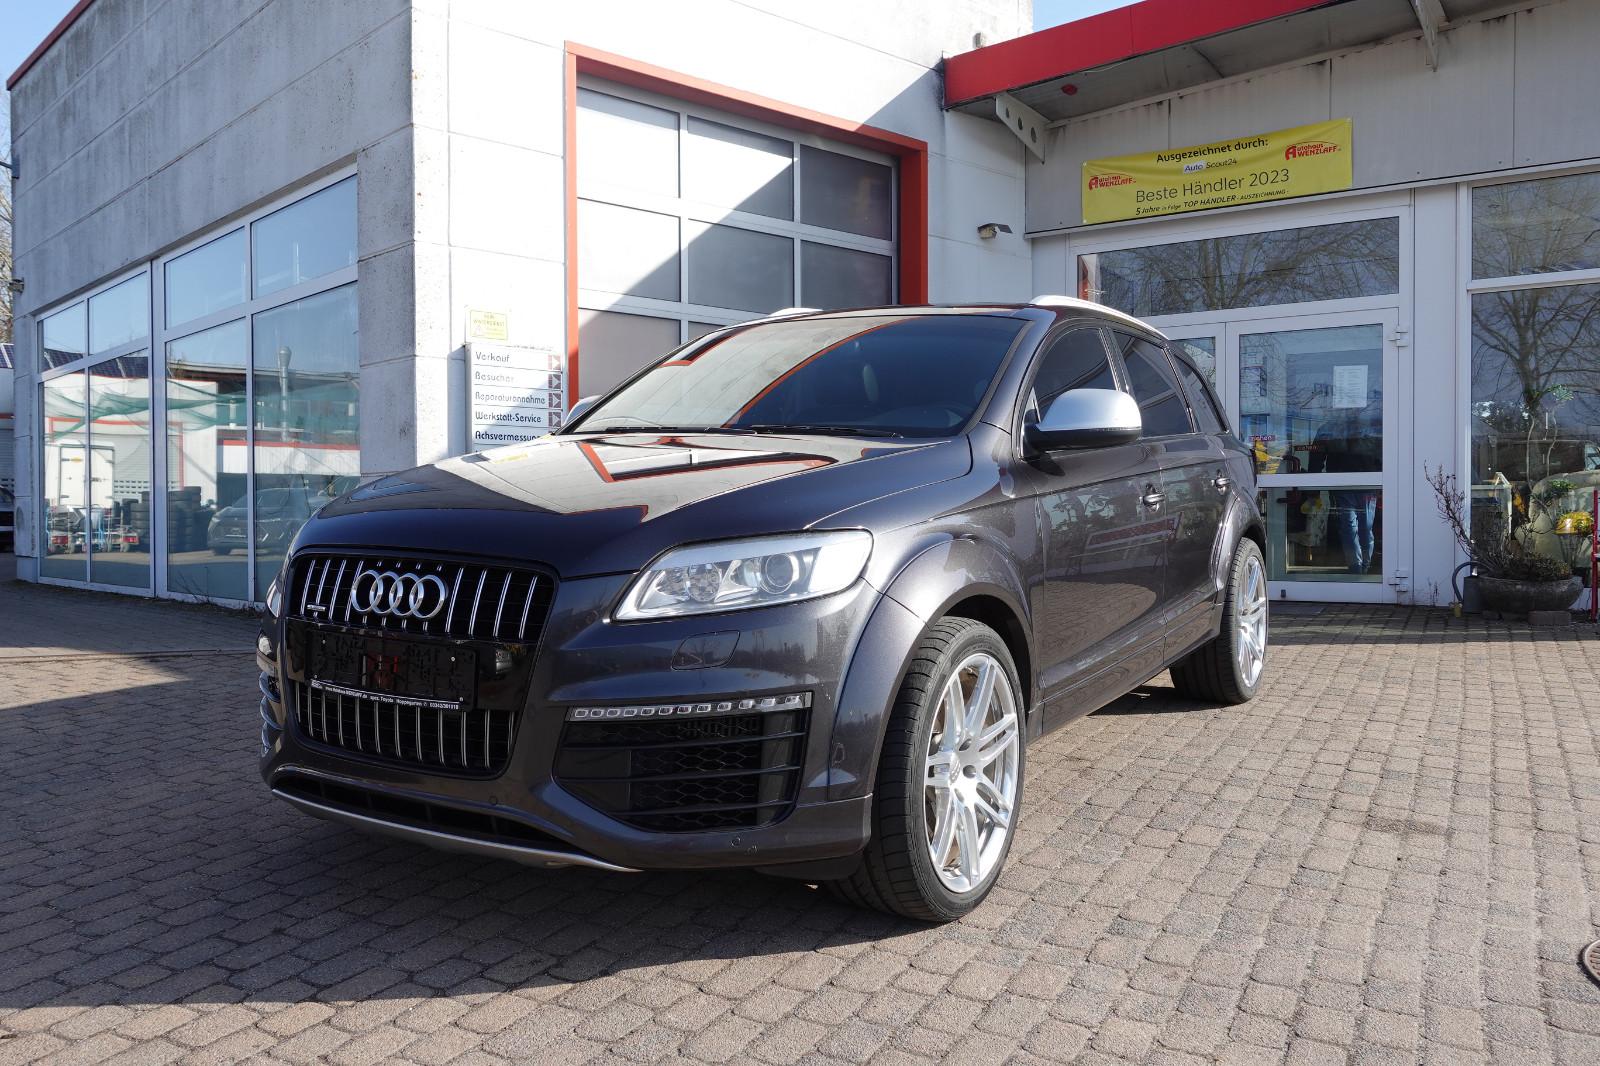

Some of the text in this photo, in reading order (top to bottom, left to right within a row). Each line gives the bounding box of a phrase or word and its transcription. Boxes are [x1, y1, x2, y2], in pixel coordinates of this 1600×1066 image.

[1156, 138, 1269, 163] Ausgezeichnet durch:
[1136, 168, 1290, 203] Beste Händler 2023
[1135, 207, 1141, 216] 5
[475, 351, 510, 362] Verkauf
[475, 371, 514, 383] Besucher
[475, 391, 546, 405] Reparaturannahme
[475, 411, 542, 423] Werkstatt-Service
